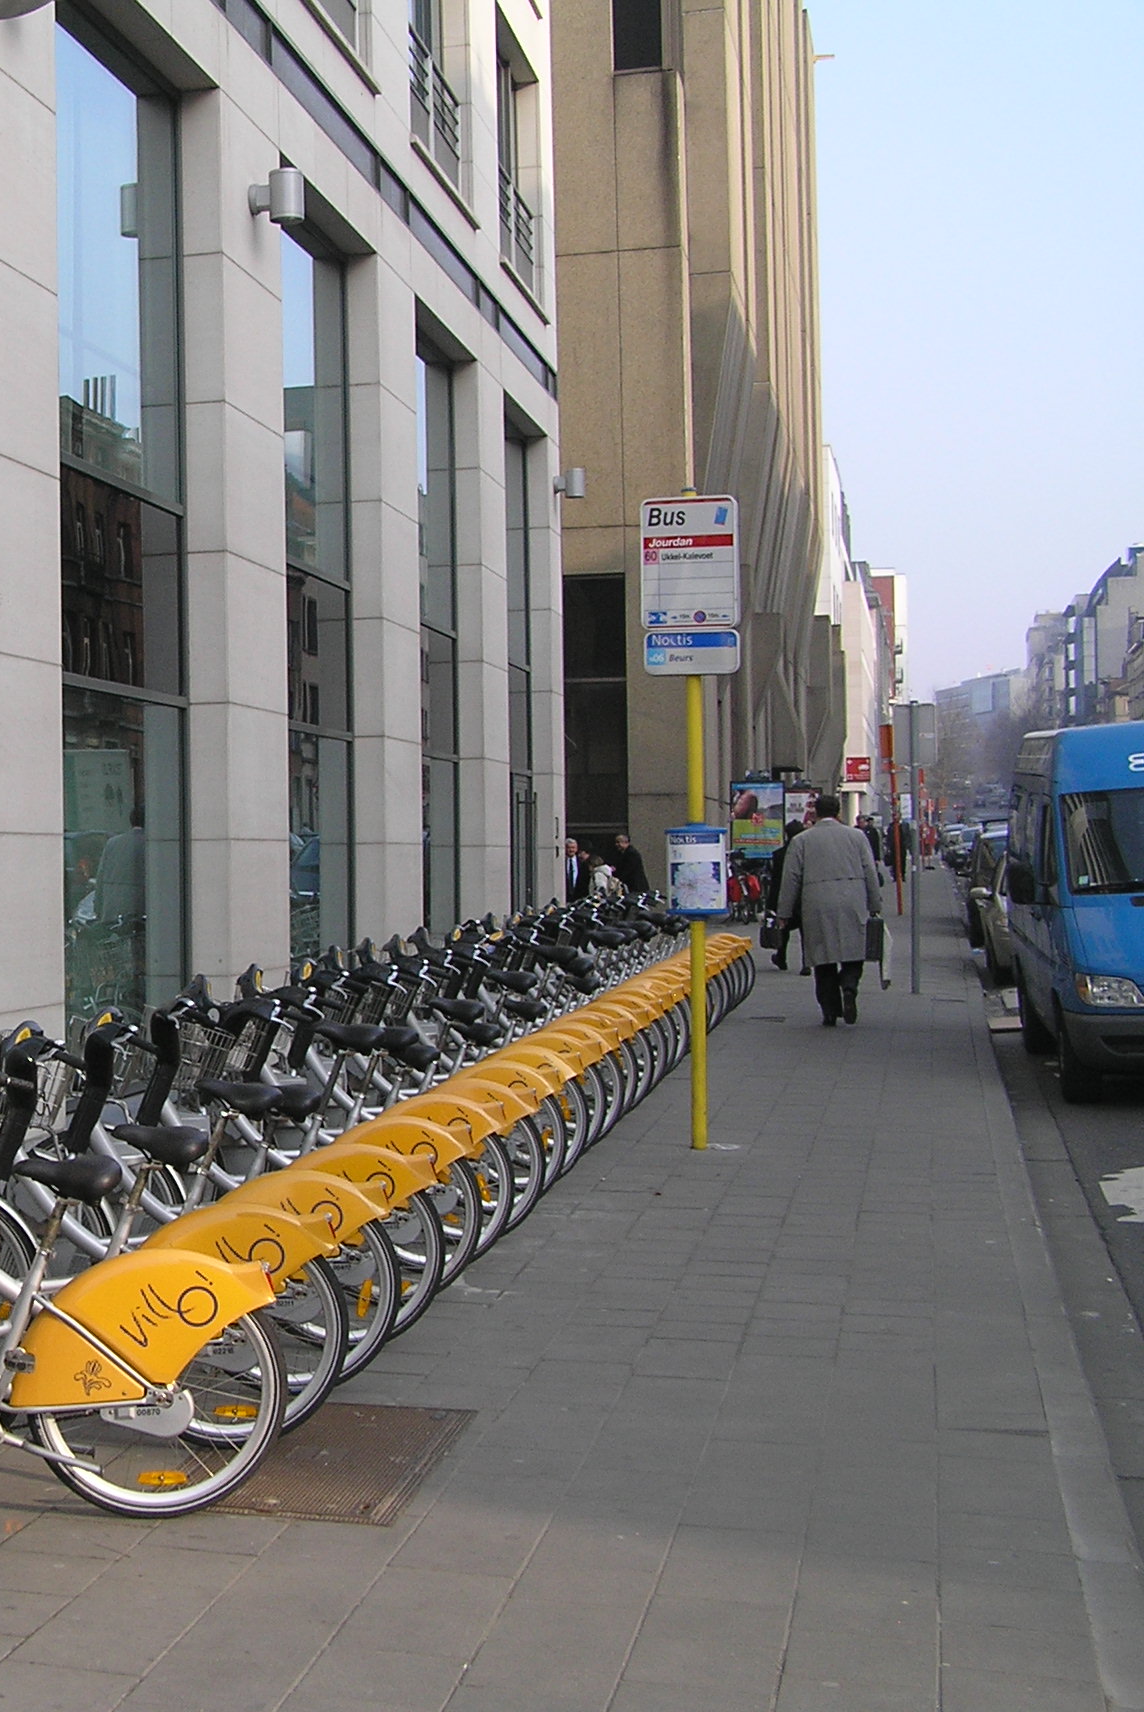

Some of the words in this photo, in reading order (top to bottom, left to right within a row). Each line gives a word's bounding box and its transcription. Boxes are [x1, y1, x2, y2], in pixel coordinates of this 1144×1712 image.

[648, 507, 686, 527] Bus
[648, 537, 694, 548] Jourdan
[644, 550, 657, 561] 60
